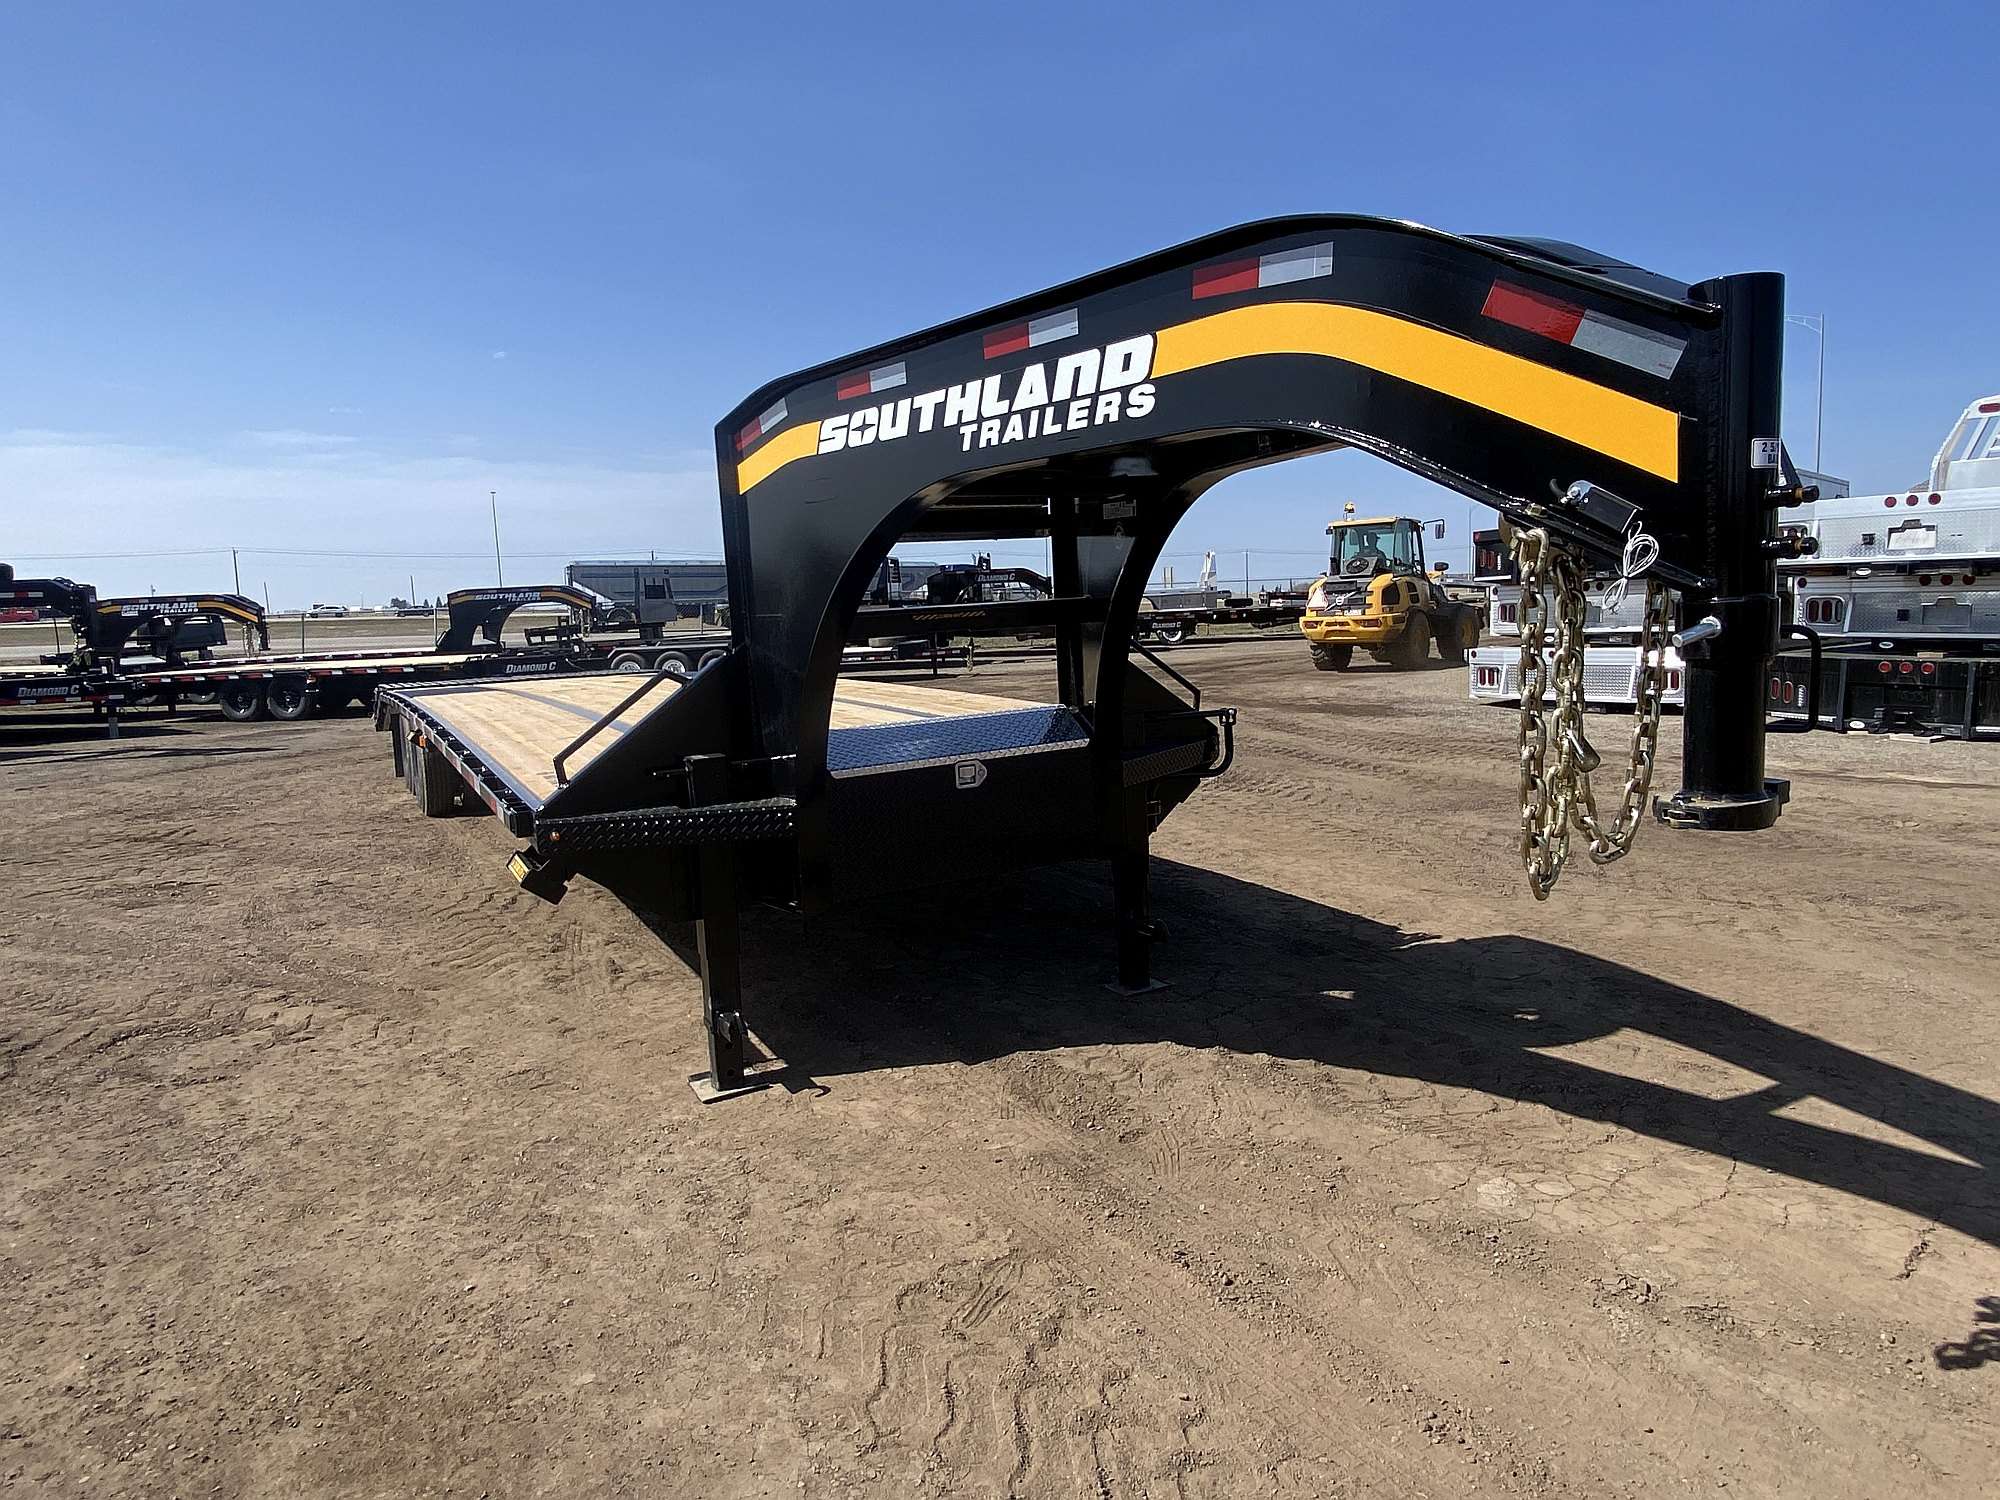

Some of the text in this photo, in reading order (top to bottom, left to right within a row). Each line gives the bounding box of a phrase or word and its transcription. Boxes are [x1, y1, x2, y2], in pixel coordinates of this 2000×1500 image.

[817, 333, 1155, 456] SOUTHLAND
[959, 382, 1156, 453] TRAILERS
[1761, 442, 1768, 453] 2
[505, 661, 557, 674] DIAMOND C
[17, 684, 80, 698] DIAMOND C
